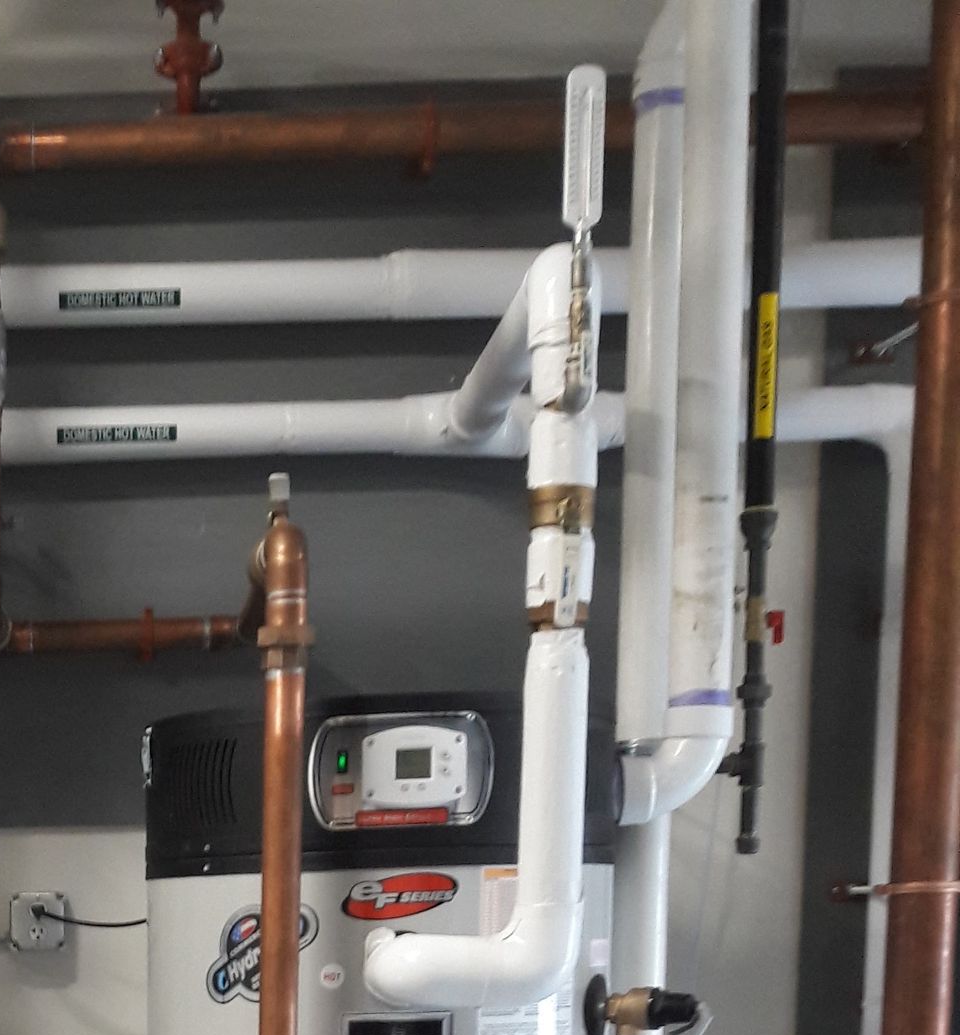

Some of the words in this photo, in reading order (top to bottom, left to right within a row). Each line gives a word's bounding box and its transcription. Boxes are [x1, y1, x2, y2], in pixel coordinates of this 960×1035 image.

[67, 293, 117, 307] DOMESTIC
[119, 292, 139, 306] HOT
[141, 291, 175, 306] WATER
[63, 428, 113, 442] DOMESTIC
[115, 427, 134, 441] HOT
[136, 426, 170, 441] WATER
[398, 889, 455, 904] SERIES
[226, 946, 261, 983] Hydr
[323, 972, 342, 982] HOT
